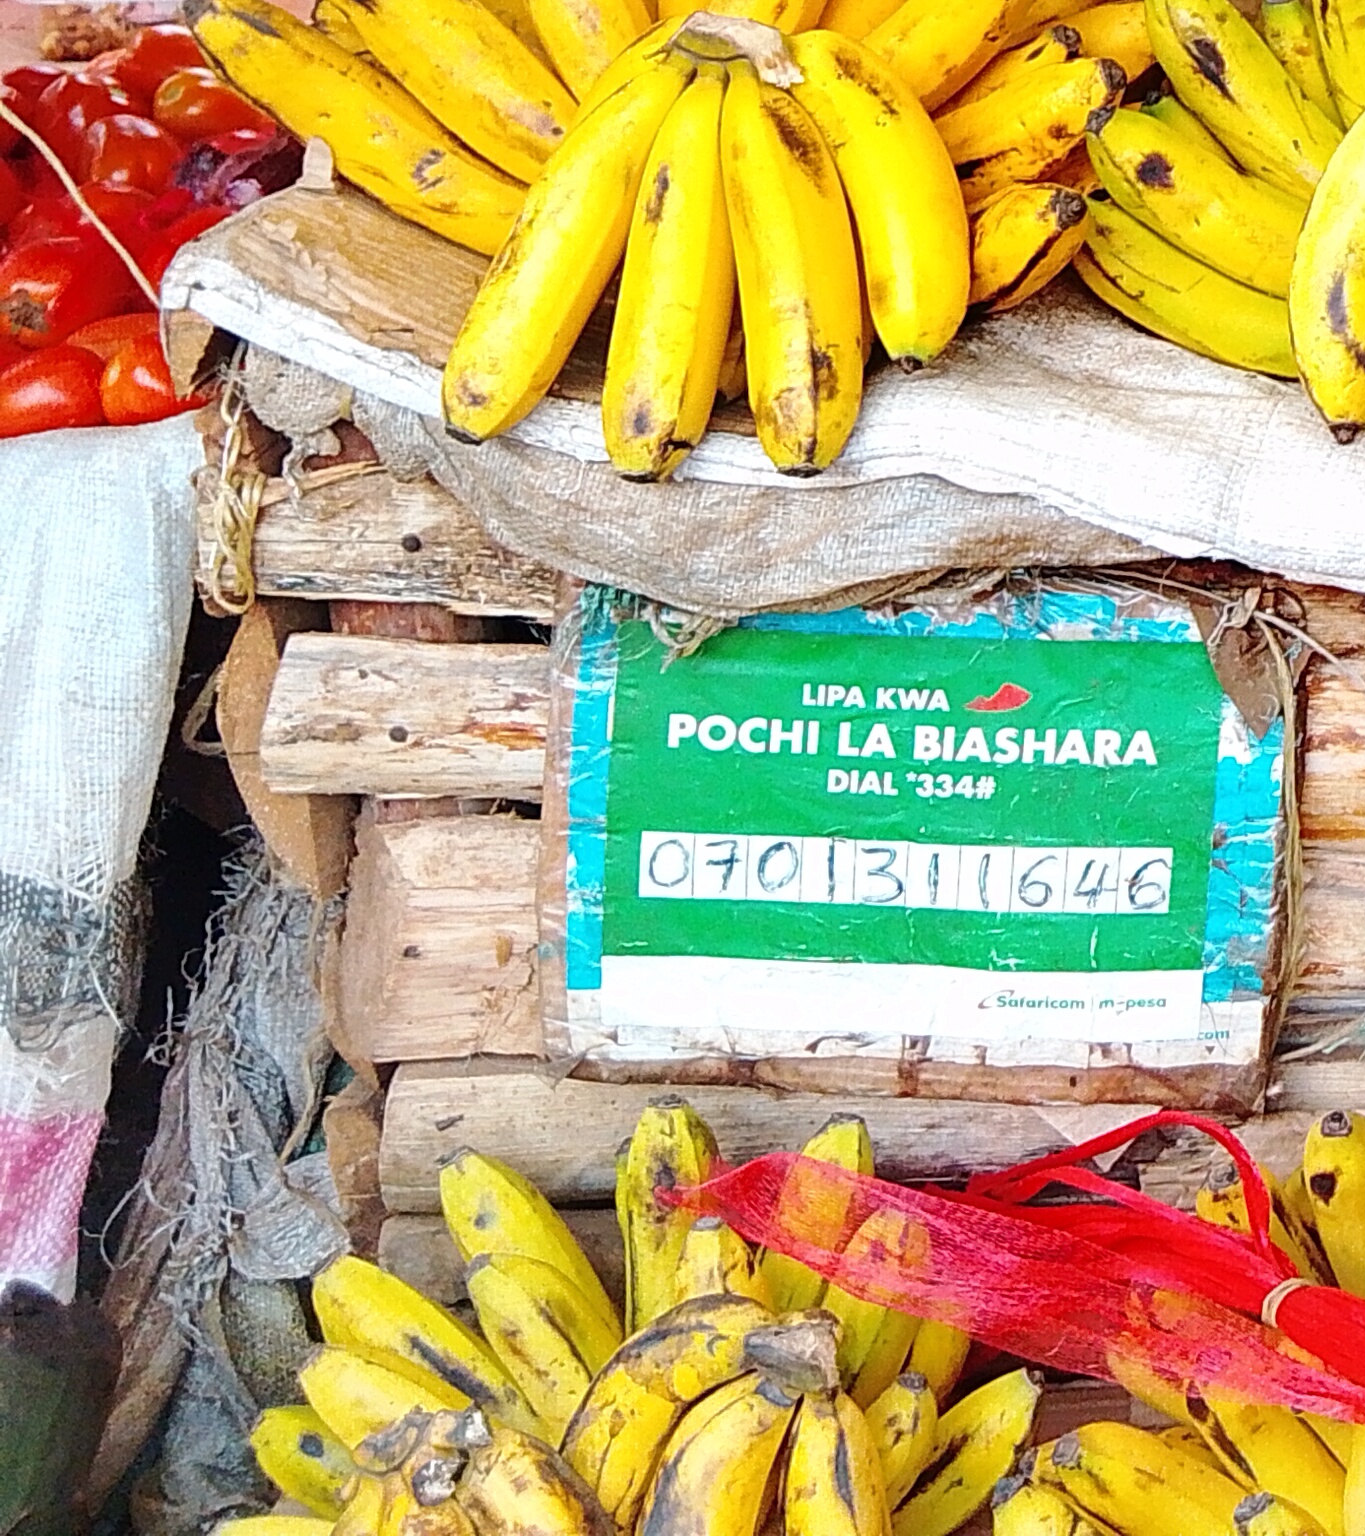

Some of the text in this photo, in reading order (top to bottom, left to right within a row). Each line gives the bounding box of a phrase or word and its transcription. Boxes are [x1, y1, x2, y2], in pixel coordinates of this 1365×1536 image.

[801, 683, 951, 712] LIPA KWA
[667, 712, 1158, 767] POCHI LA BIASHARA
[826, 768, 899, 797] DIAL
[995, 993, 1085, 1010] Safaricom
